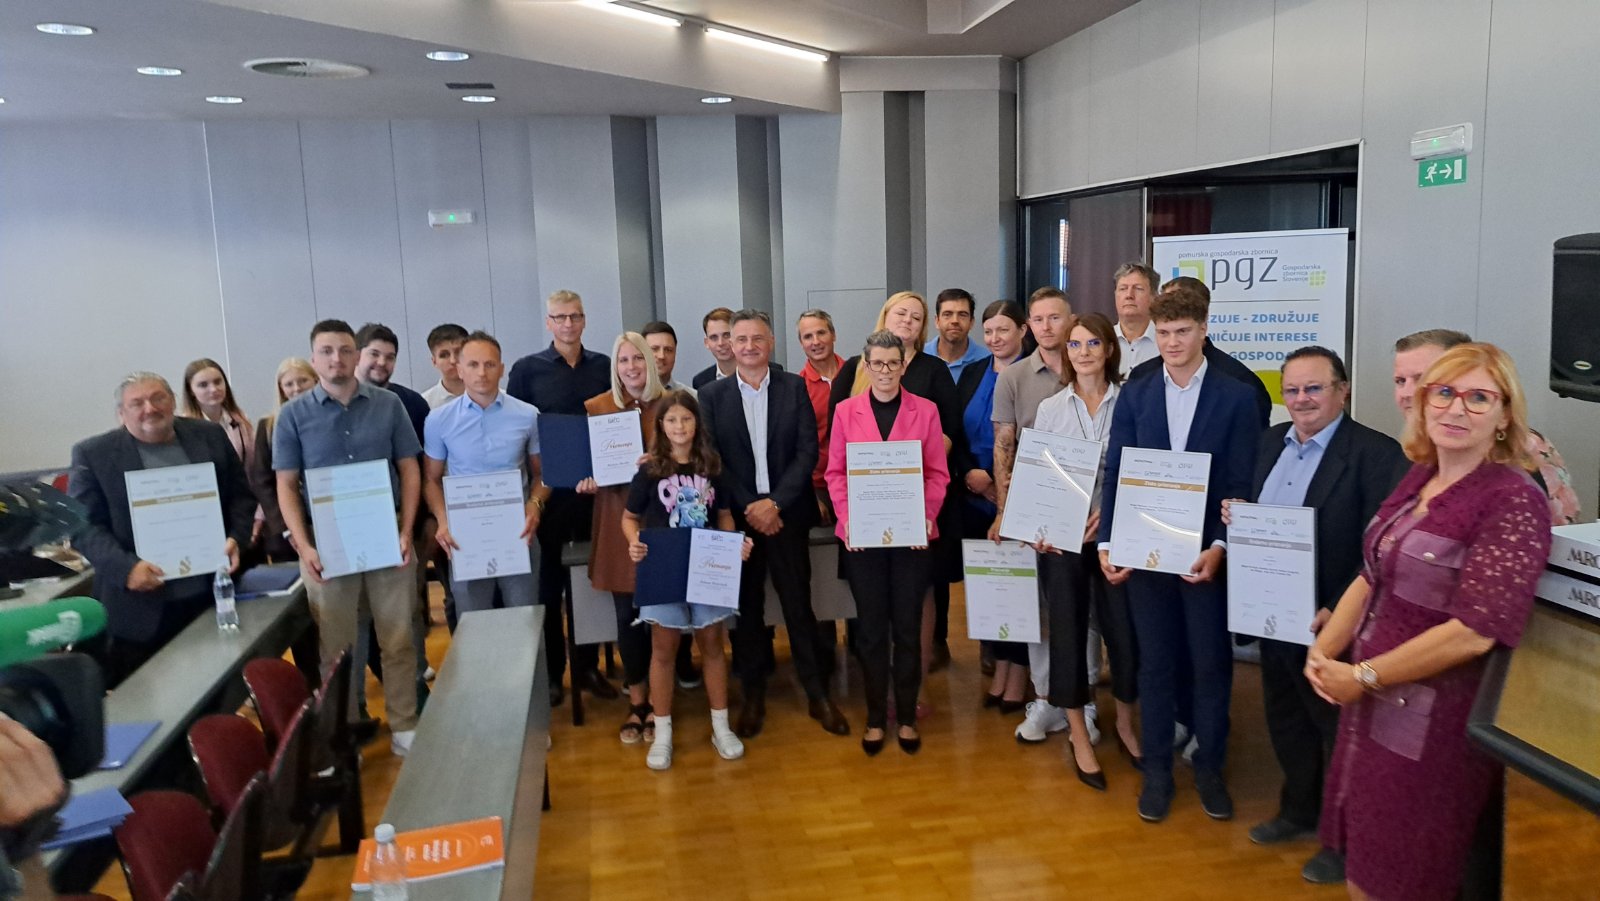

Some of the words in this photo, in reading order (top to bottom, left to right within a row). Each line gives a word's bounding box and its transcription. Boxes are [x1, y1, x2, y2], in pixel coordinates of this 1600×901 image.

[1178, 250, 1209, 259] pomurska
[1210, 249, 1248, 258] gospodarska
[1212, 256, 1278, 291] pgz
[1251, 311, 1319, 323] ZDRUŽUJE
[1254, 332, 1317, 342] INTERESE
[1229, 351, 1289, 361] GOSPOD
